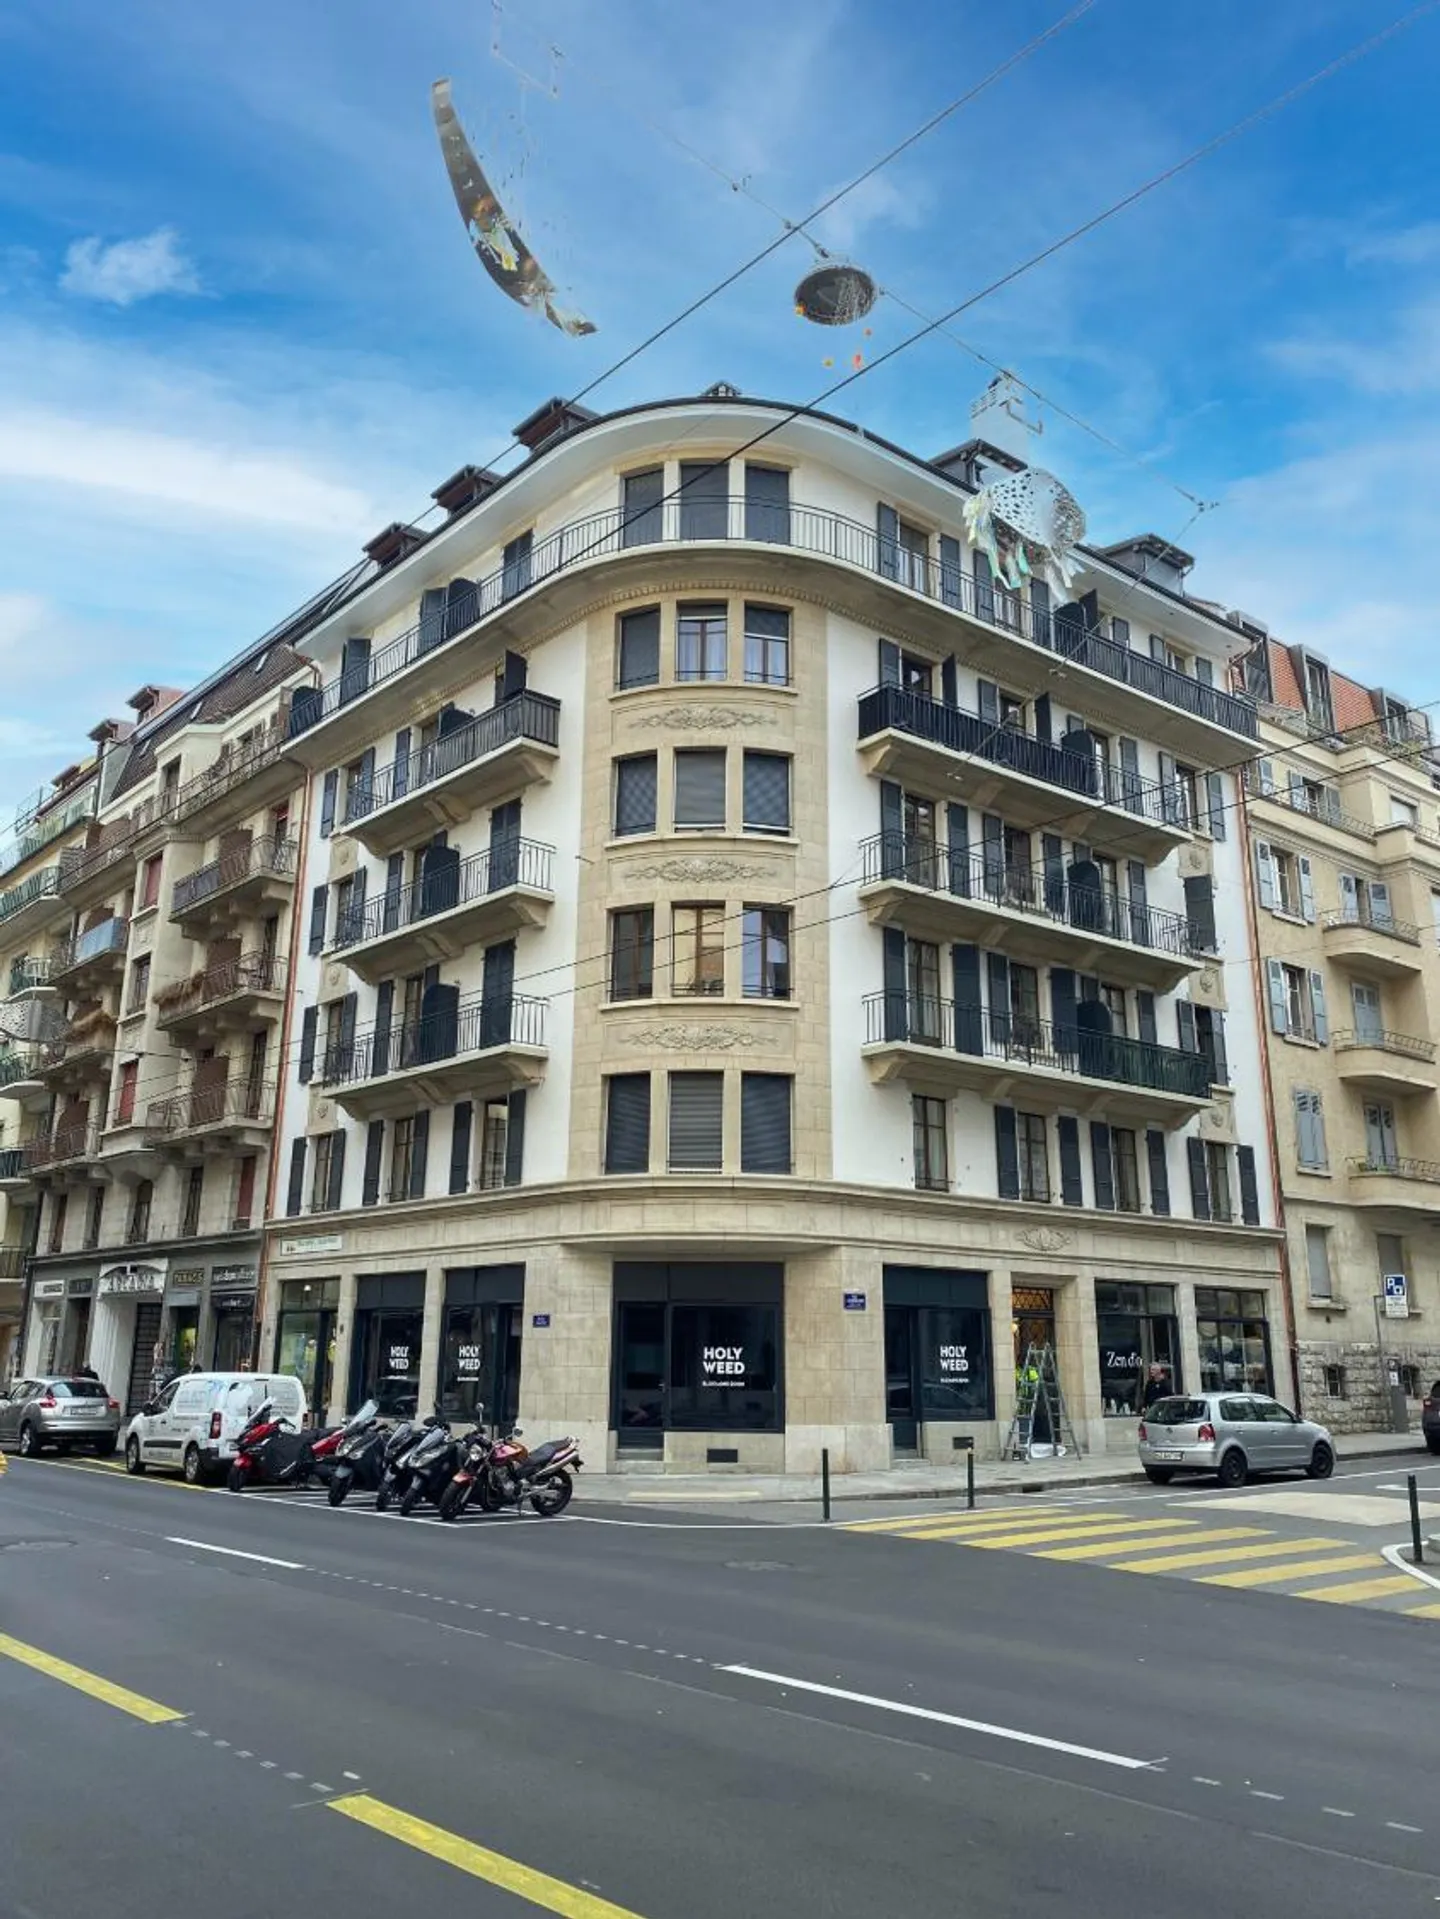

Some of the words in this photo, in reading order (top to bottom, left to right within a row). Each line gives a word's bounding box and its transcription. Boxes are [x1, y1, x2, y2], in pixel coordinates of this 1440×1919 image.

[390, 1346, 409, 1358] HOLY
[459, 1345, 480, 1358] HOLY
[703, 1346, 743, 1360] HOLY
[940, 1345, 967, 1358] HOLY
[389, 1358, 409, 1370] WEED
[458, 1358, 480, 1370] WEED
[702, 1361, 746, 1375] WEED
[940, 1359, 969, 1371] WEED
